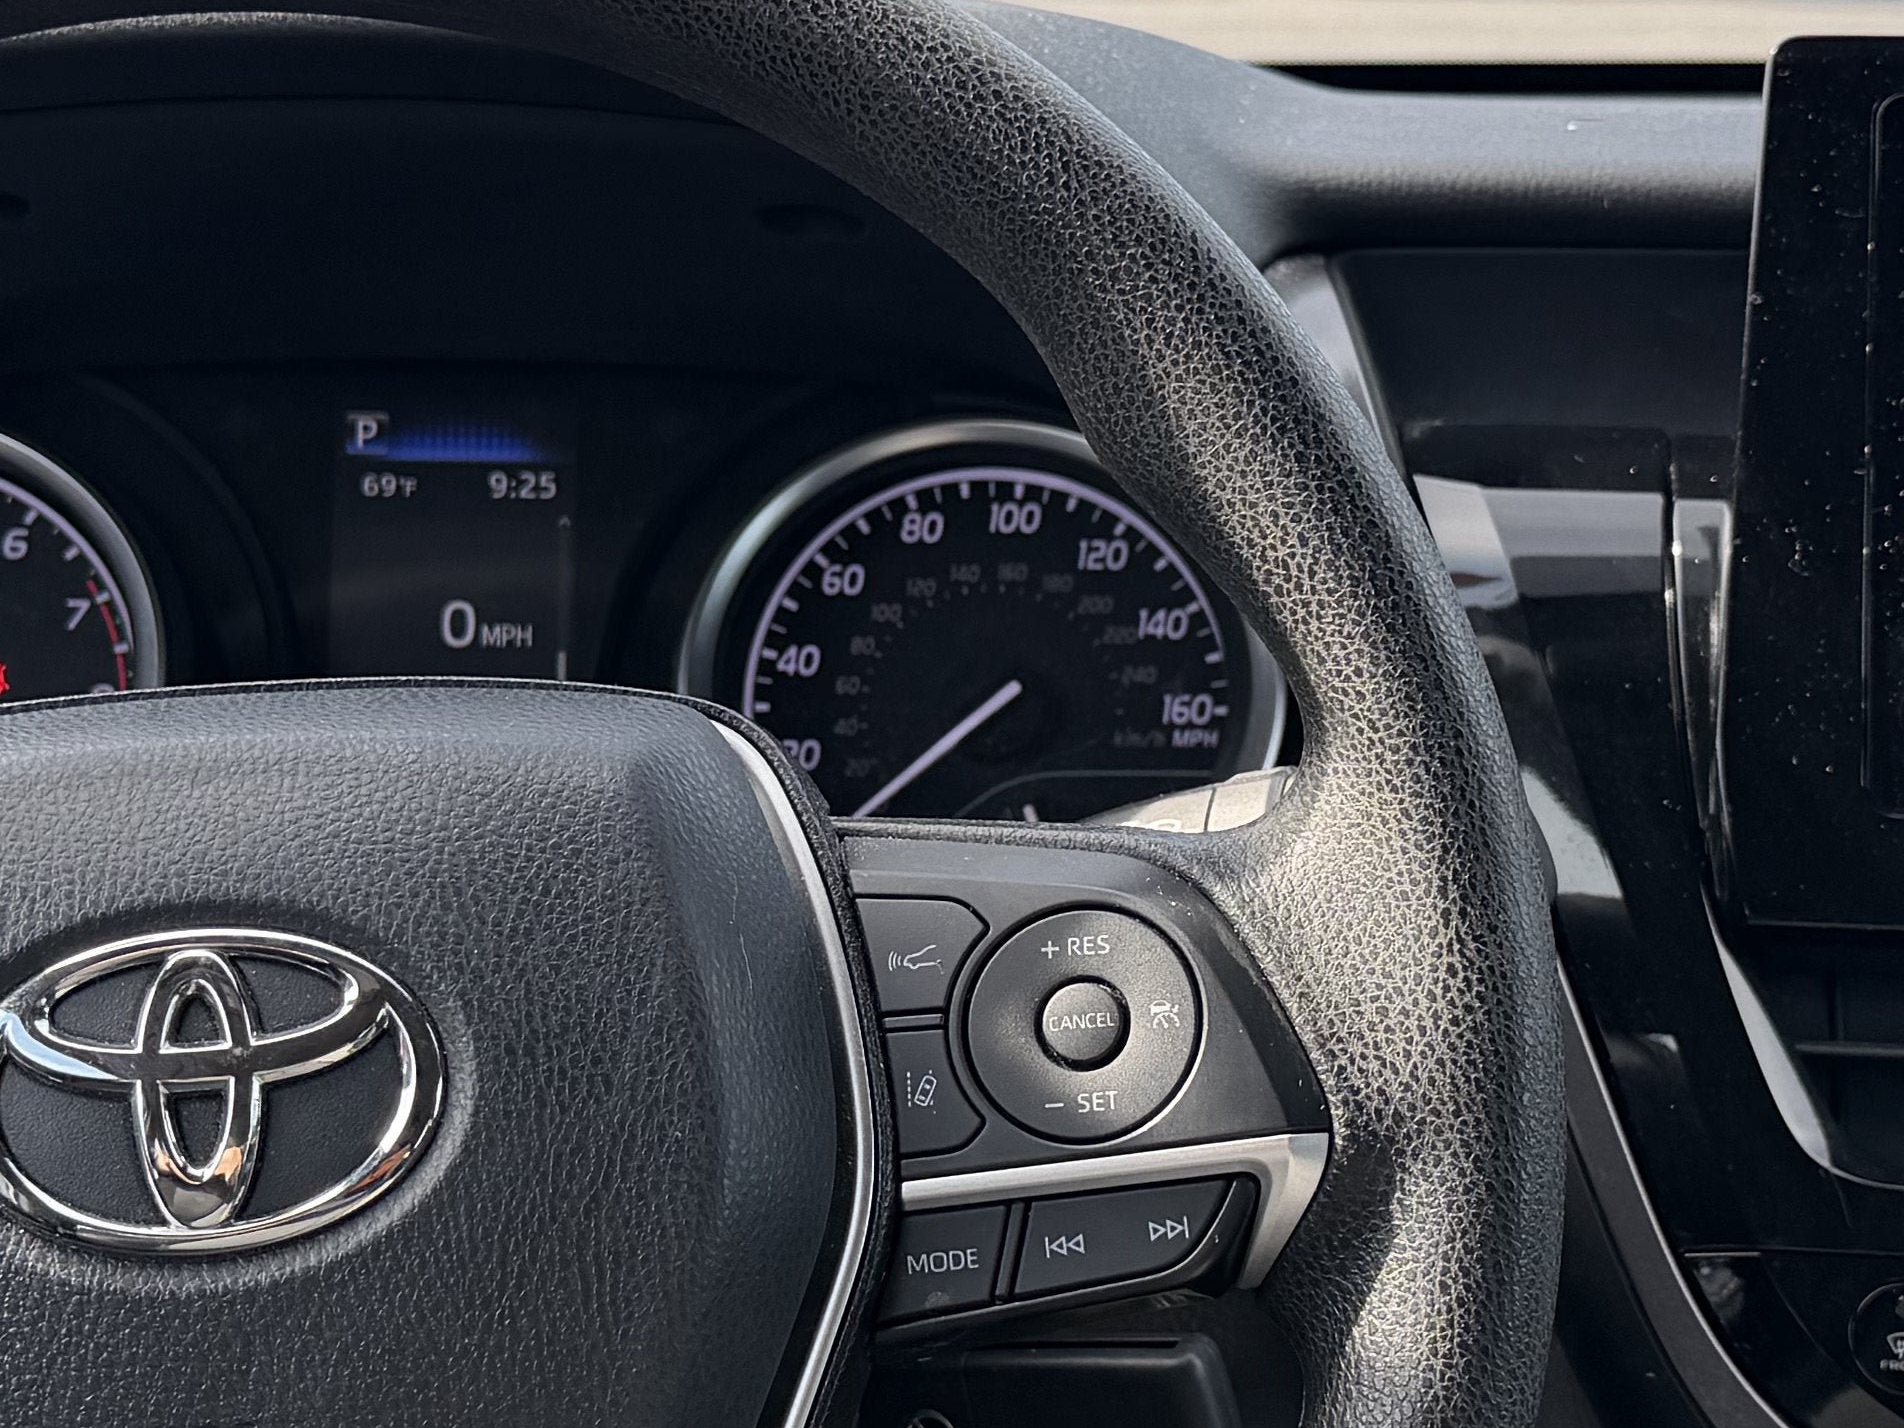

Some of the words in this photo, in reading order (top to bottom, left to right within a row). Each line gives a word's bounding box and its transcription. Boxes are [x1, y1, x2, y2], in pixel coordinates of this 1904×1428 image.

[487, 470, 558, 500] 9:25
[899, 511, 945, 544] 80
[988, 501, 1043, 534] 100
[2, 526, 29, 561] 6
[1077, 539, 1130, 571] 120
[820, 563, 866, 597] 60
[64, 597, 92, 631] 7
[440, 598, 478, 650] 0
[481, 624, 534, 649] MPH
[1137, 606, 1190, 641] 140
[776, 644, 822, 678] 40
[1161, 694, 1214, 725] 160
[1172, 728, 1219, 749] MPH
[1047, 1010, 1116, 1032] CANCEL
[906, 1247, 979, 1275] MODE
